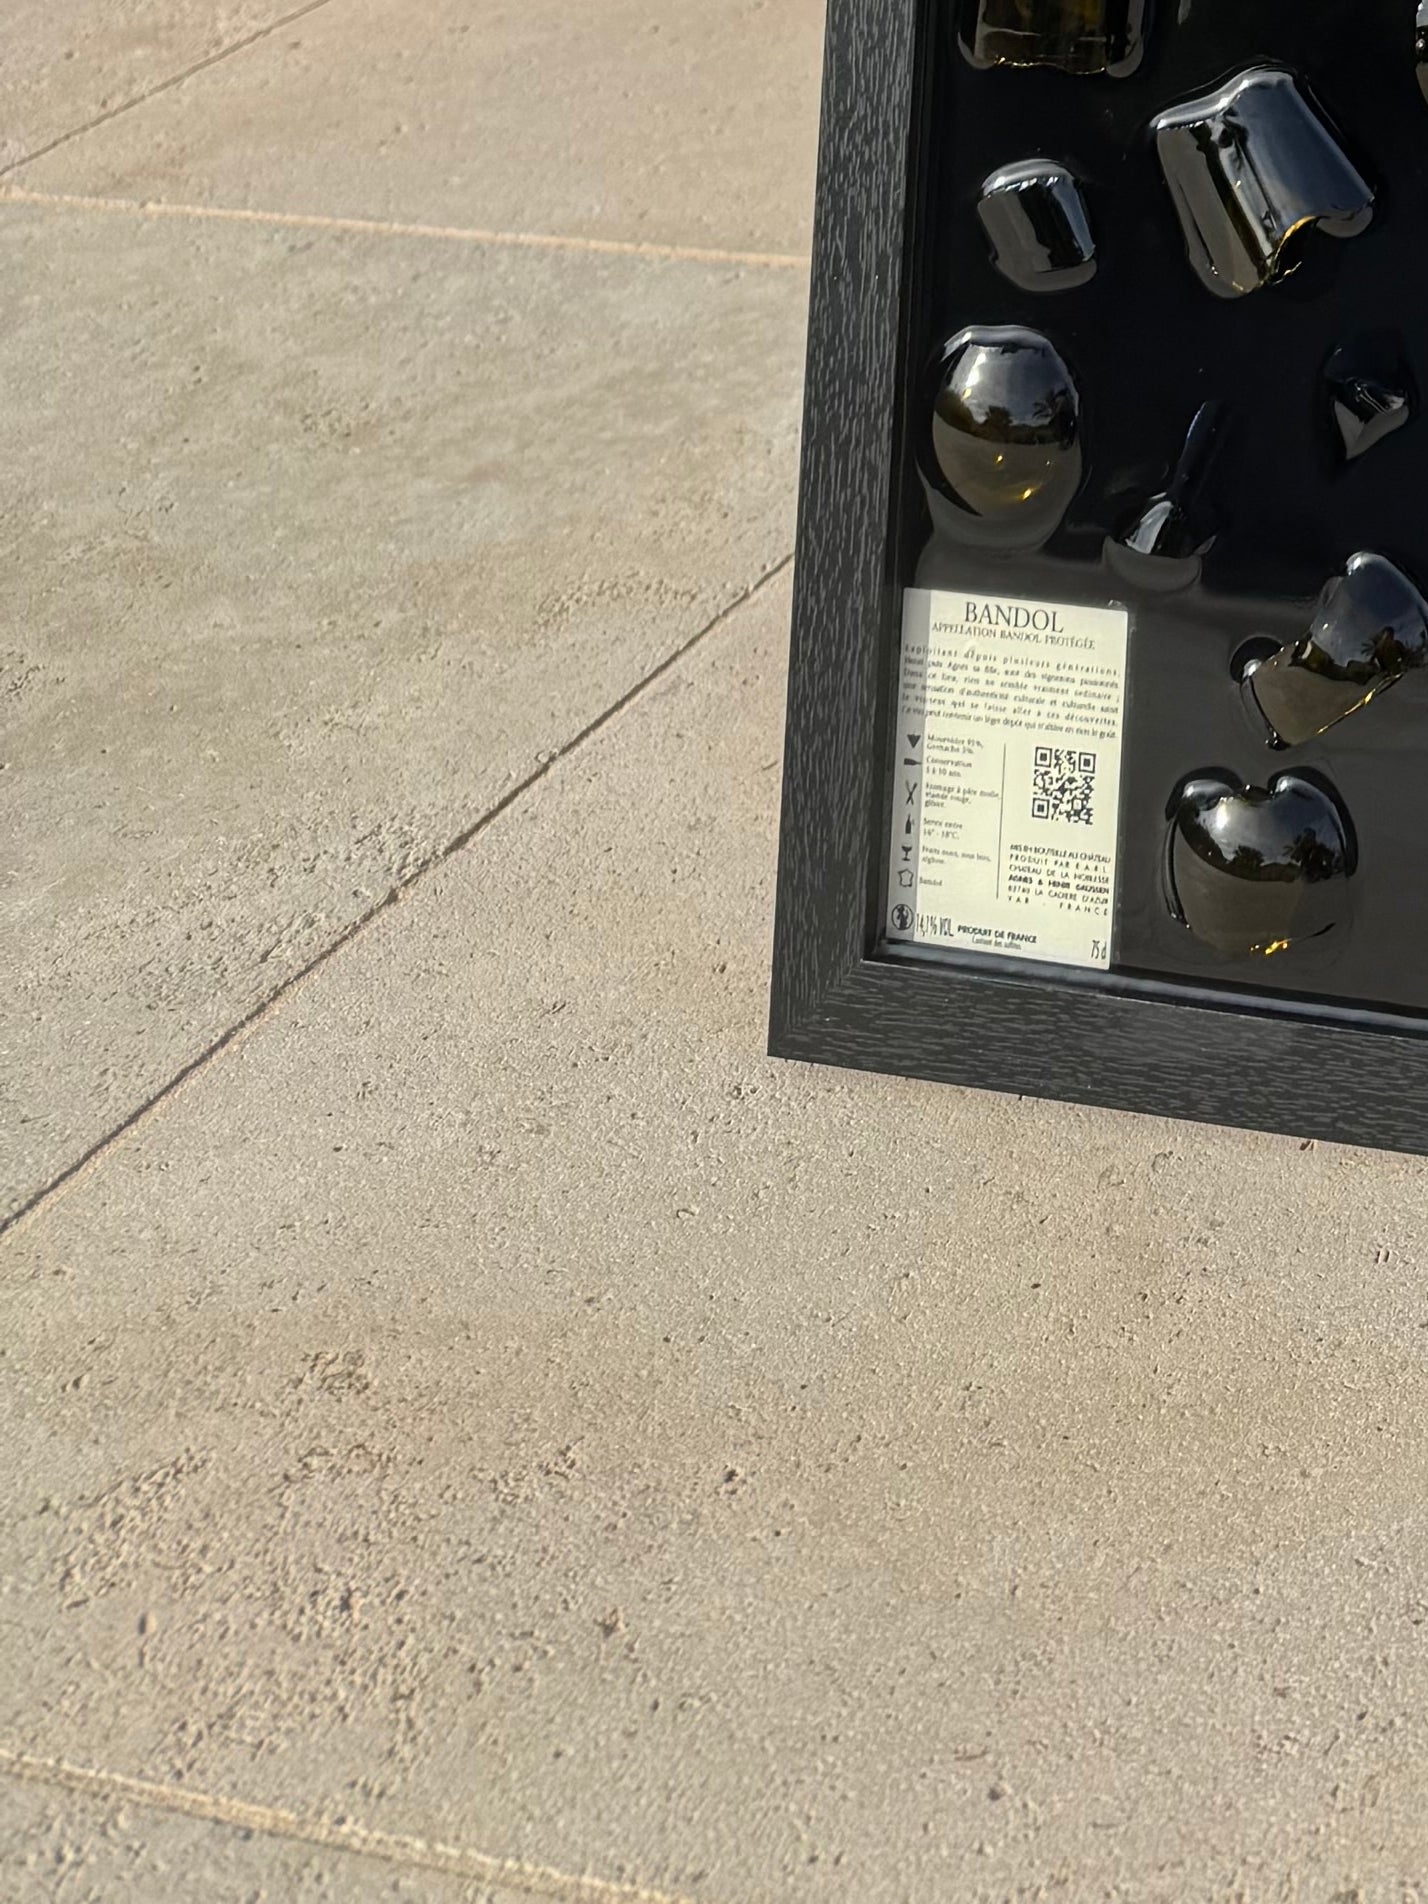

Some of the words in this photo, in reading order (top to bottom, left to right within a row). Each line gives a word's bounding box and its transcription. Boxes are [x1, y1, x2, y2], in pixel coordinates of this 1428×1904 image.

[965, 602, 1064, 633] BANDOL
[932, 622, 996, 638] APPELLATION
[1000, 630, 1042, 644] BANDOL
[1060, 902, 1107, 916] FRANCE
[957, 924, 992, 936] PRODUIT
[995, 930, 1004, 939] DE
[1007, 932, 1037, 943] FRANCE
[1091, 940, 1100, 959] 75
